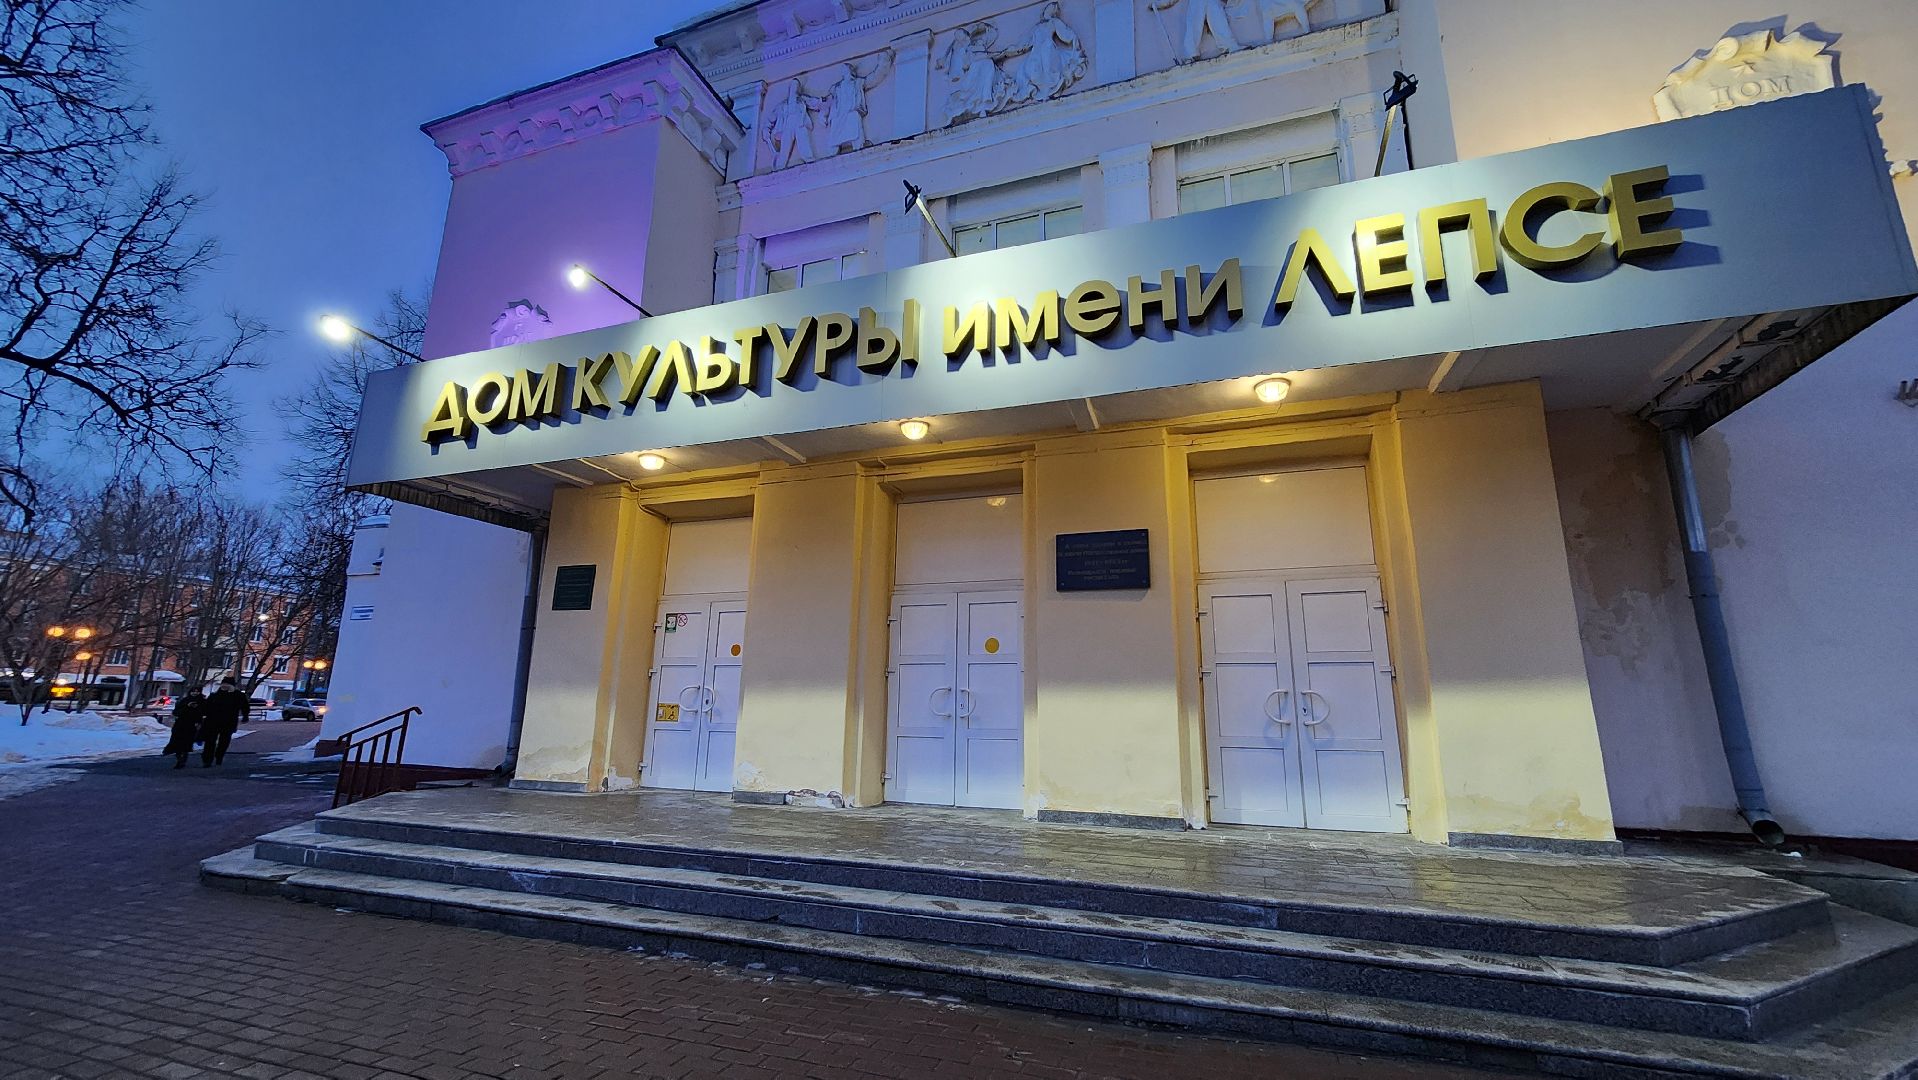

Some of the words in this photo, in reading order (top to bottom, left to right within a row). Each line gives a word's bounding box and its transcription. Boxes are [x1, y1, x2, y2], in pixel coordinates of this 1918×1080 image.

[421, 362, 565, 443] ДОМ
[572, 299, 920, 416] КУЛЬТУРЫ
[943, 258, 1243, 357] имени
[1274, 165, 1683, 311] ЛЕПСЕ
